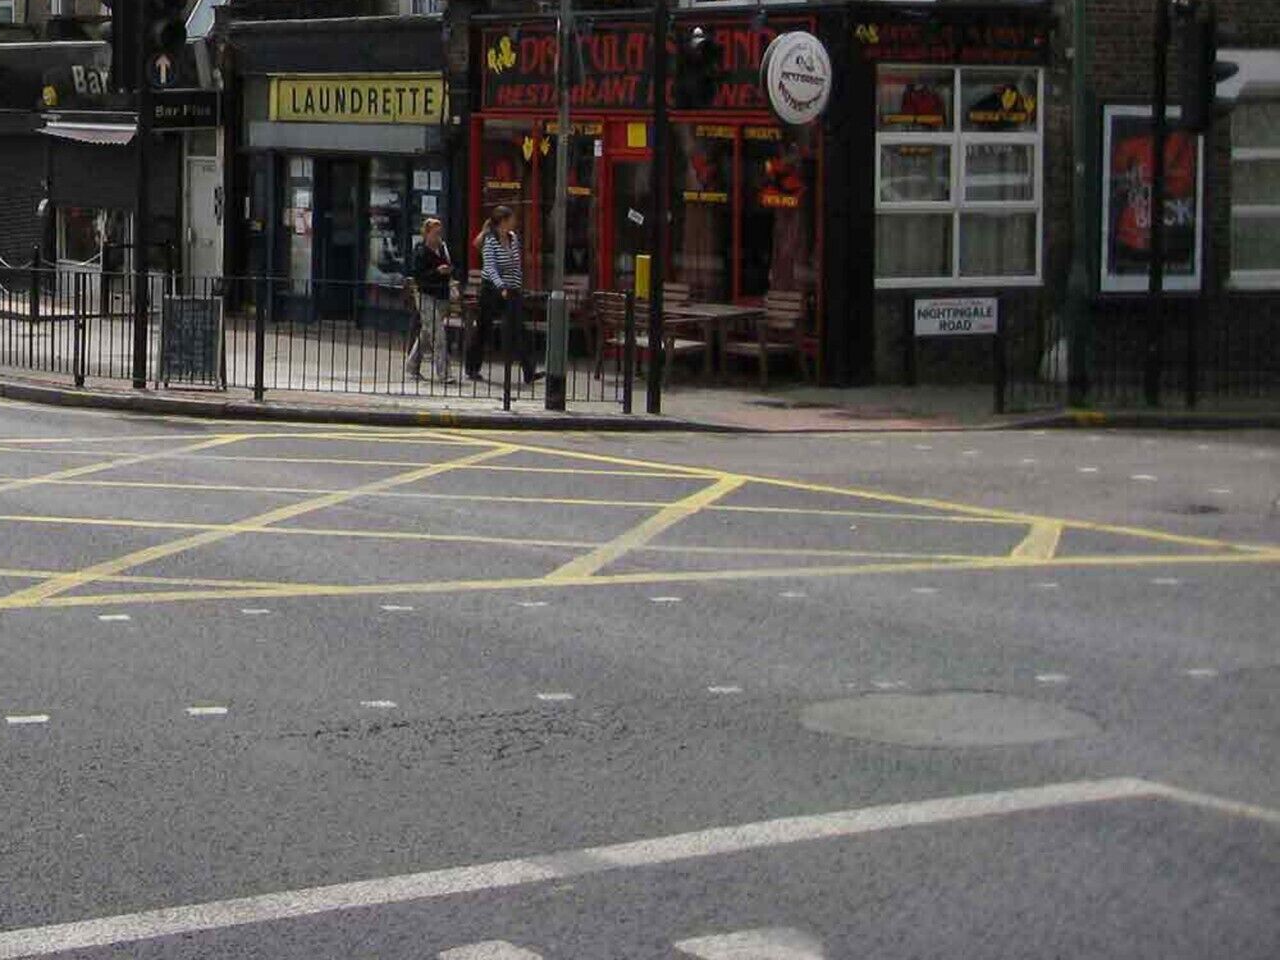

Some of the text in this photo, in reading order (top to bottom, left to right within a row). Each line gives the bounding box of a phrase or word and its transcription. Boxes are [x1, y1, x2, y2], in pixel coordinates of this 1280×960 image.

[71, 65, 109, 95] Bar
[291, 85, 435, 116] LAUNDRETTE
[916, 305, 994, 321] NIGHTINGALE
[938, 319, 972, 332] ROAD
